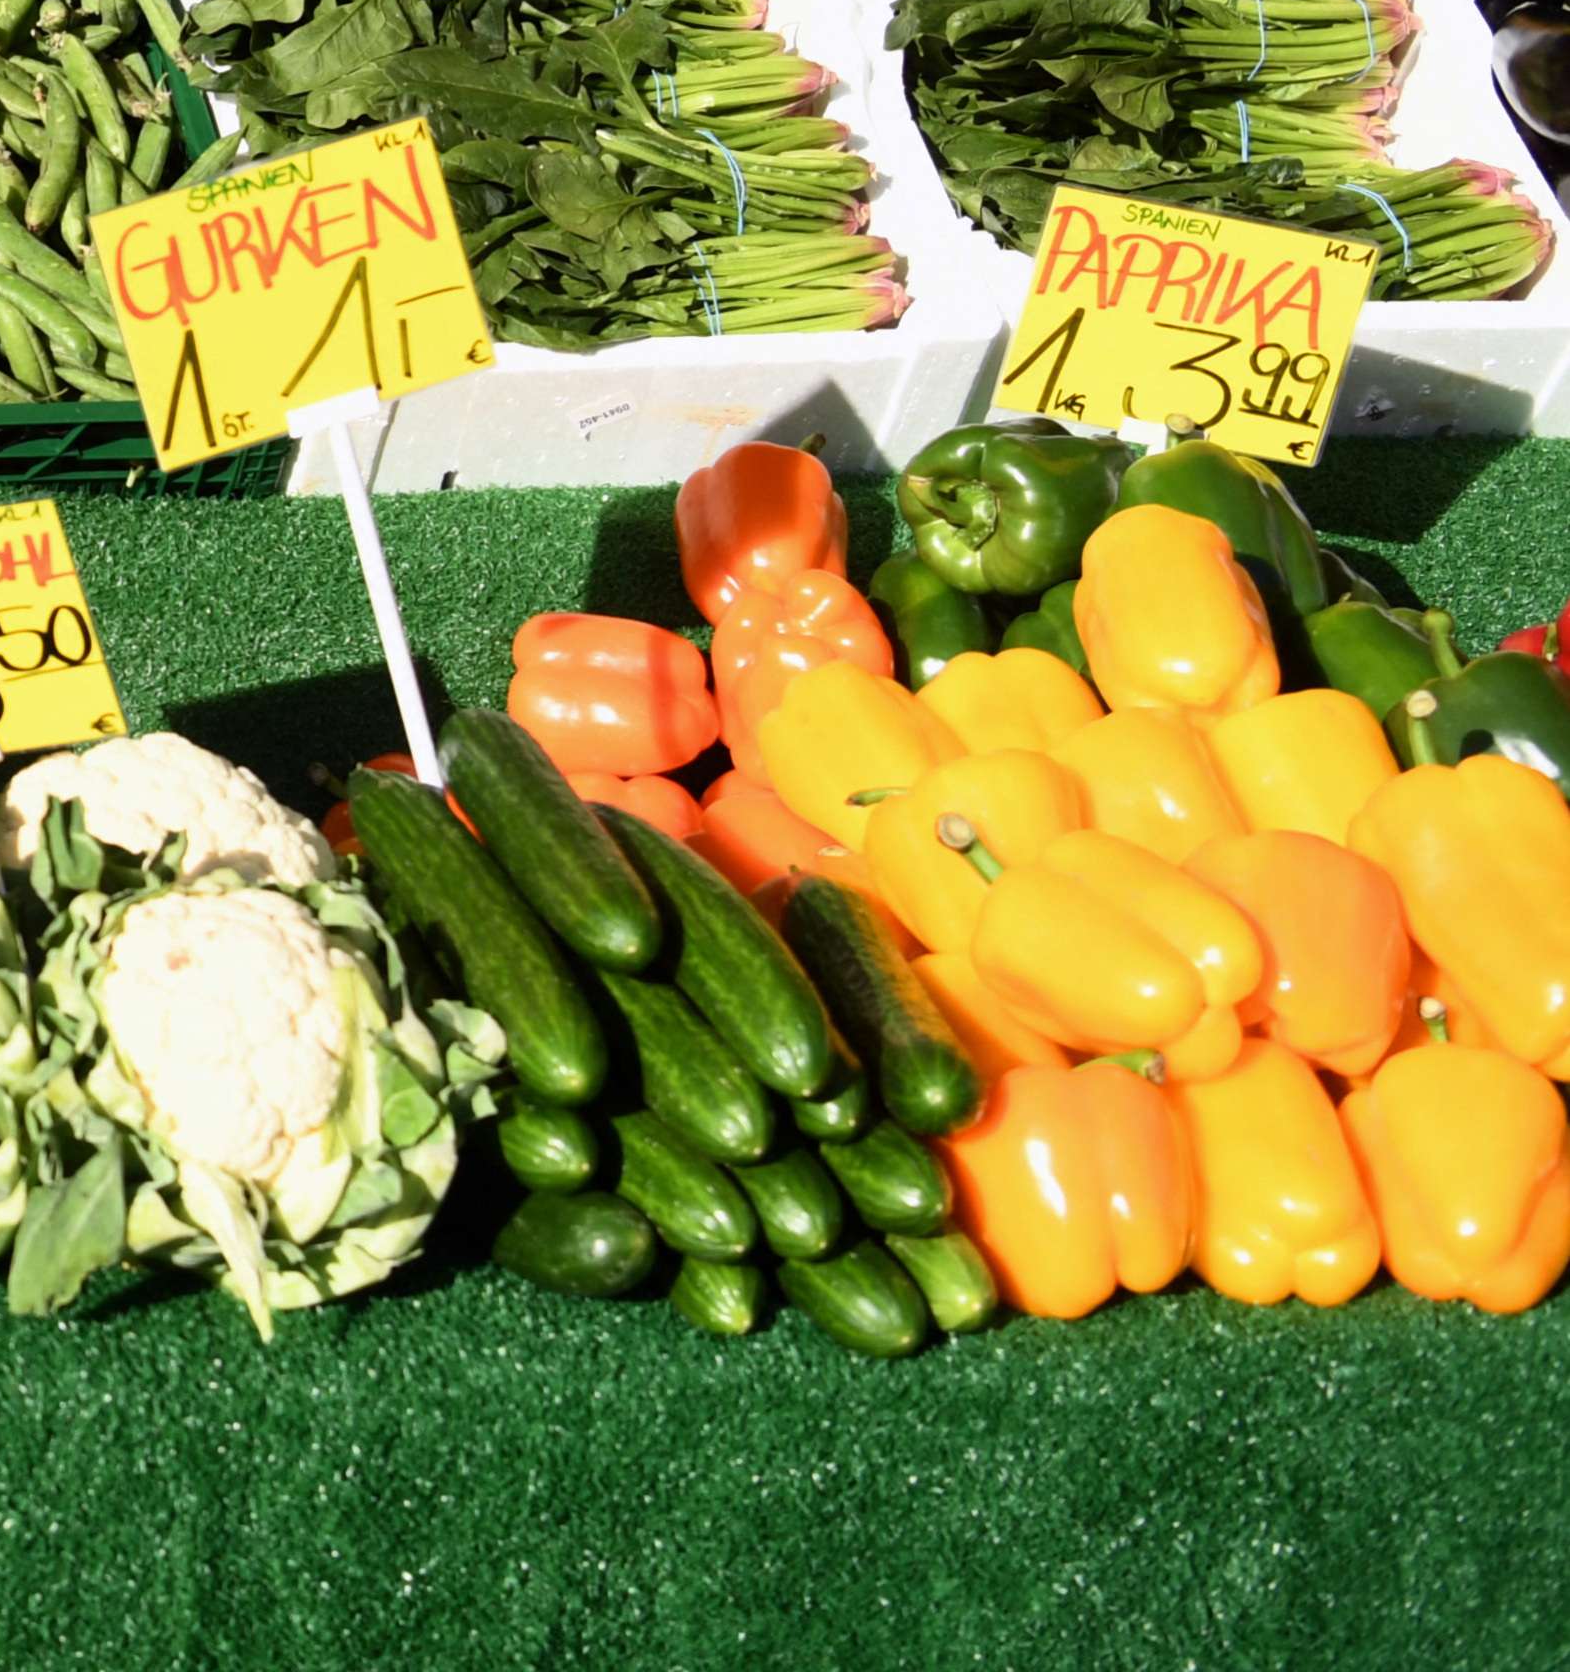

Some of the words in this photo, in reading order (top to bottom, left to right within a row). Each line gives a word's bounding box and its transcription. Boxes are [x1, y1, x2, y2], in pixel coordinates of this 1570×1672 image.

[187, 149, 314, 213] SPANIEN
[1121, 203, 1222, 241] SPANIEN
[115, 144, 438, 326] GURKEN
[1035, 205, 1322, 350] PAPRIKA
